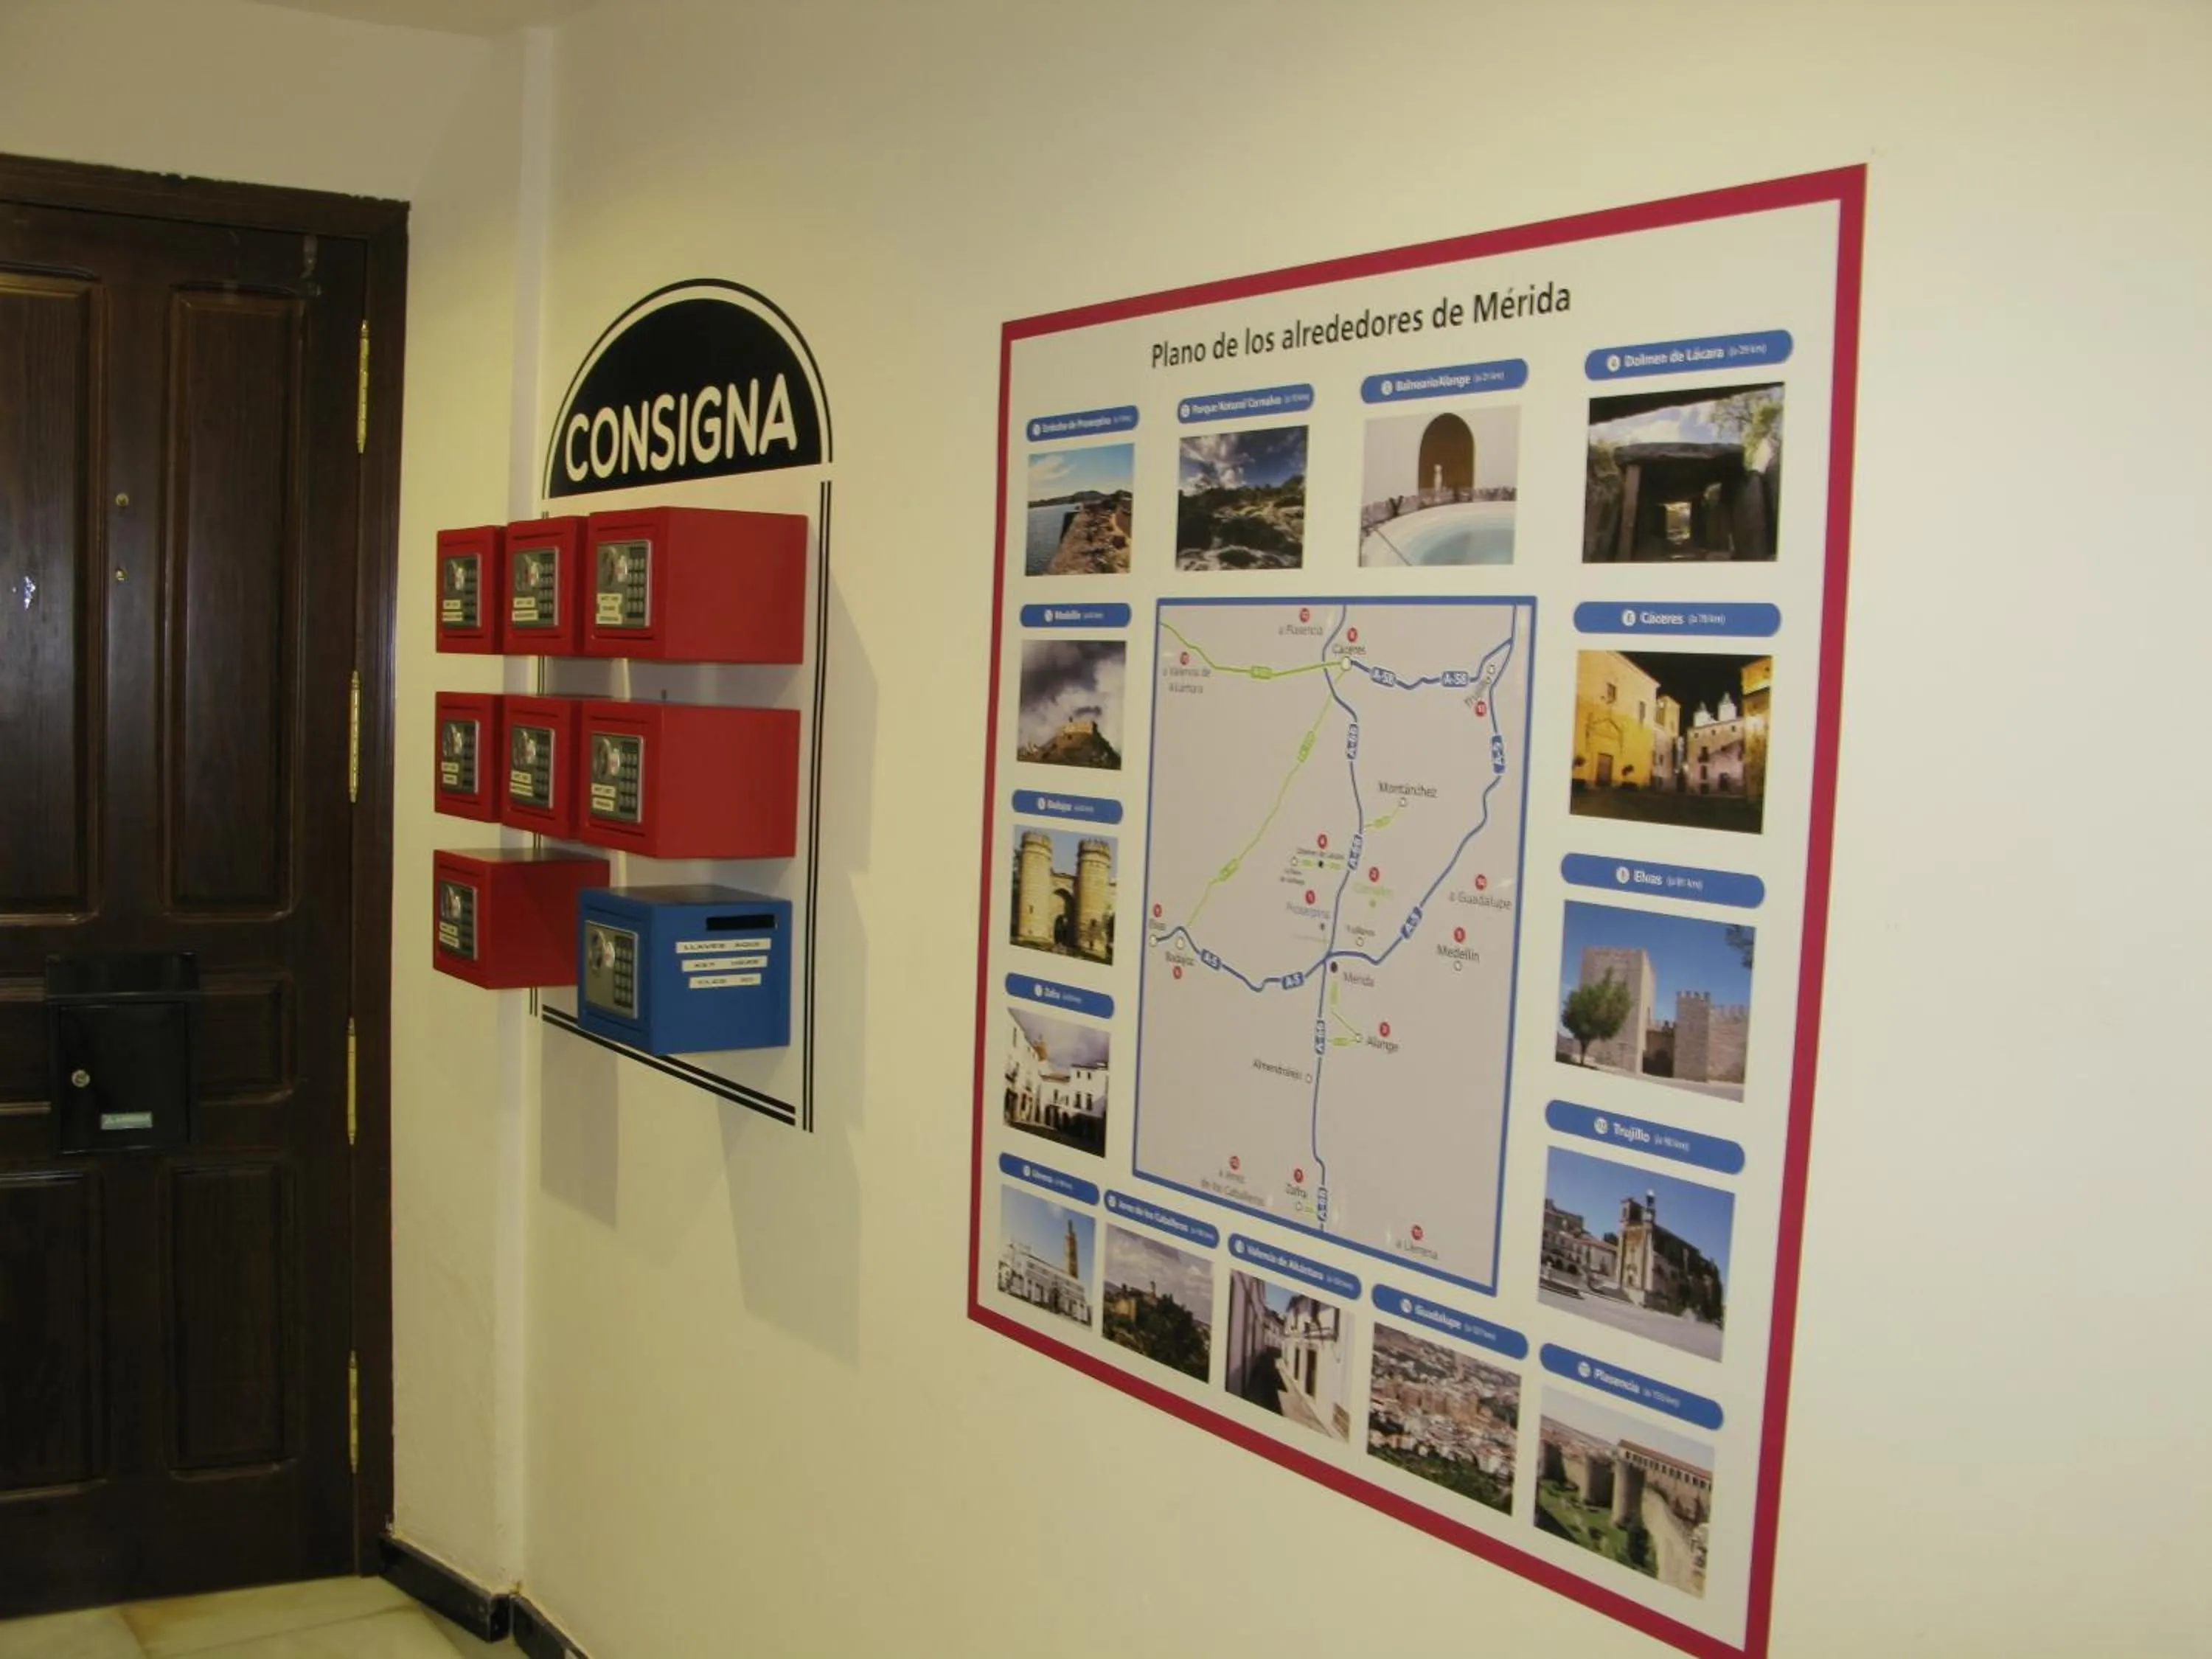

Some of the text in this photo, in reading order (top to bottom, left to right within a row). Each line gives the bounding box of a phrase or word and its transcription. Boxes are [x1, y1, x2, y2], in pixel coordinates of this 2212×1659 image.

[1152, 281, 1571, 368] Plano de los alrededores de Mérida
[1624, 353, 1667, 368] Dolmen
[1669, 349, 1684, 364] de
[566, 373, 797, 481] CONSIGNA
[1613, 1122, 1651, 1144] Trujillo
